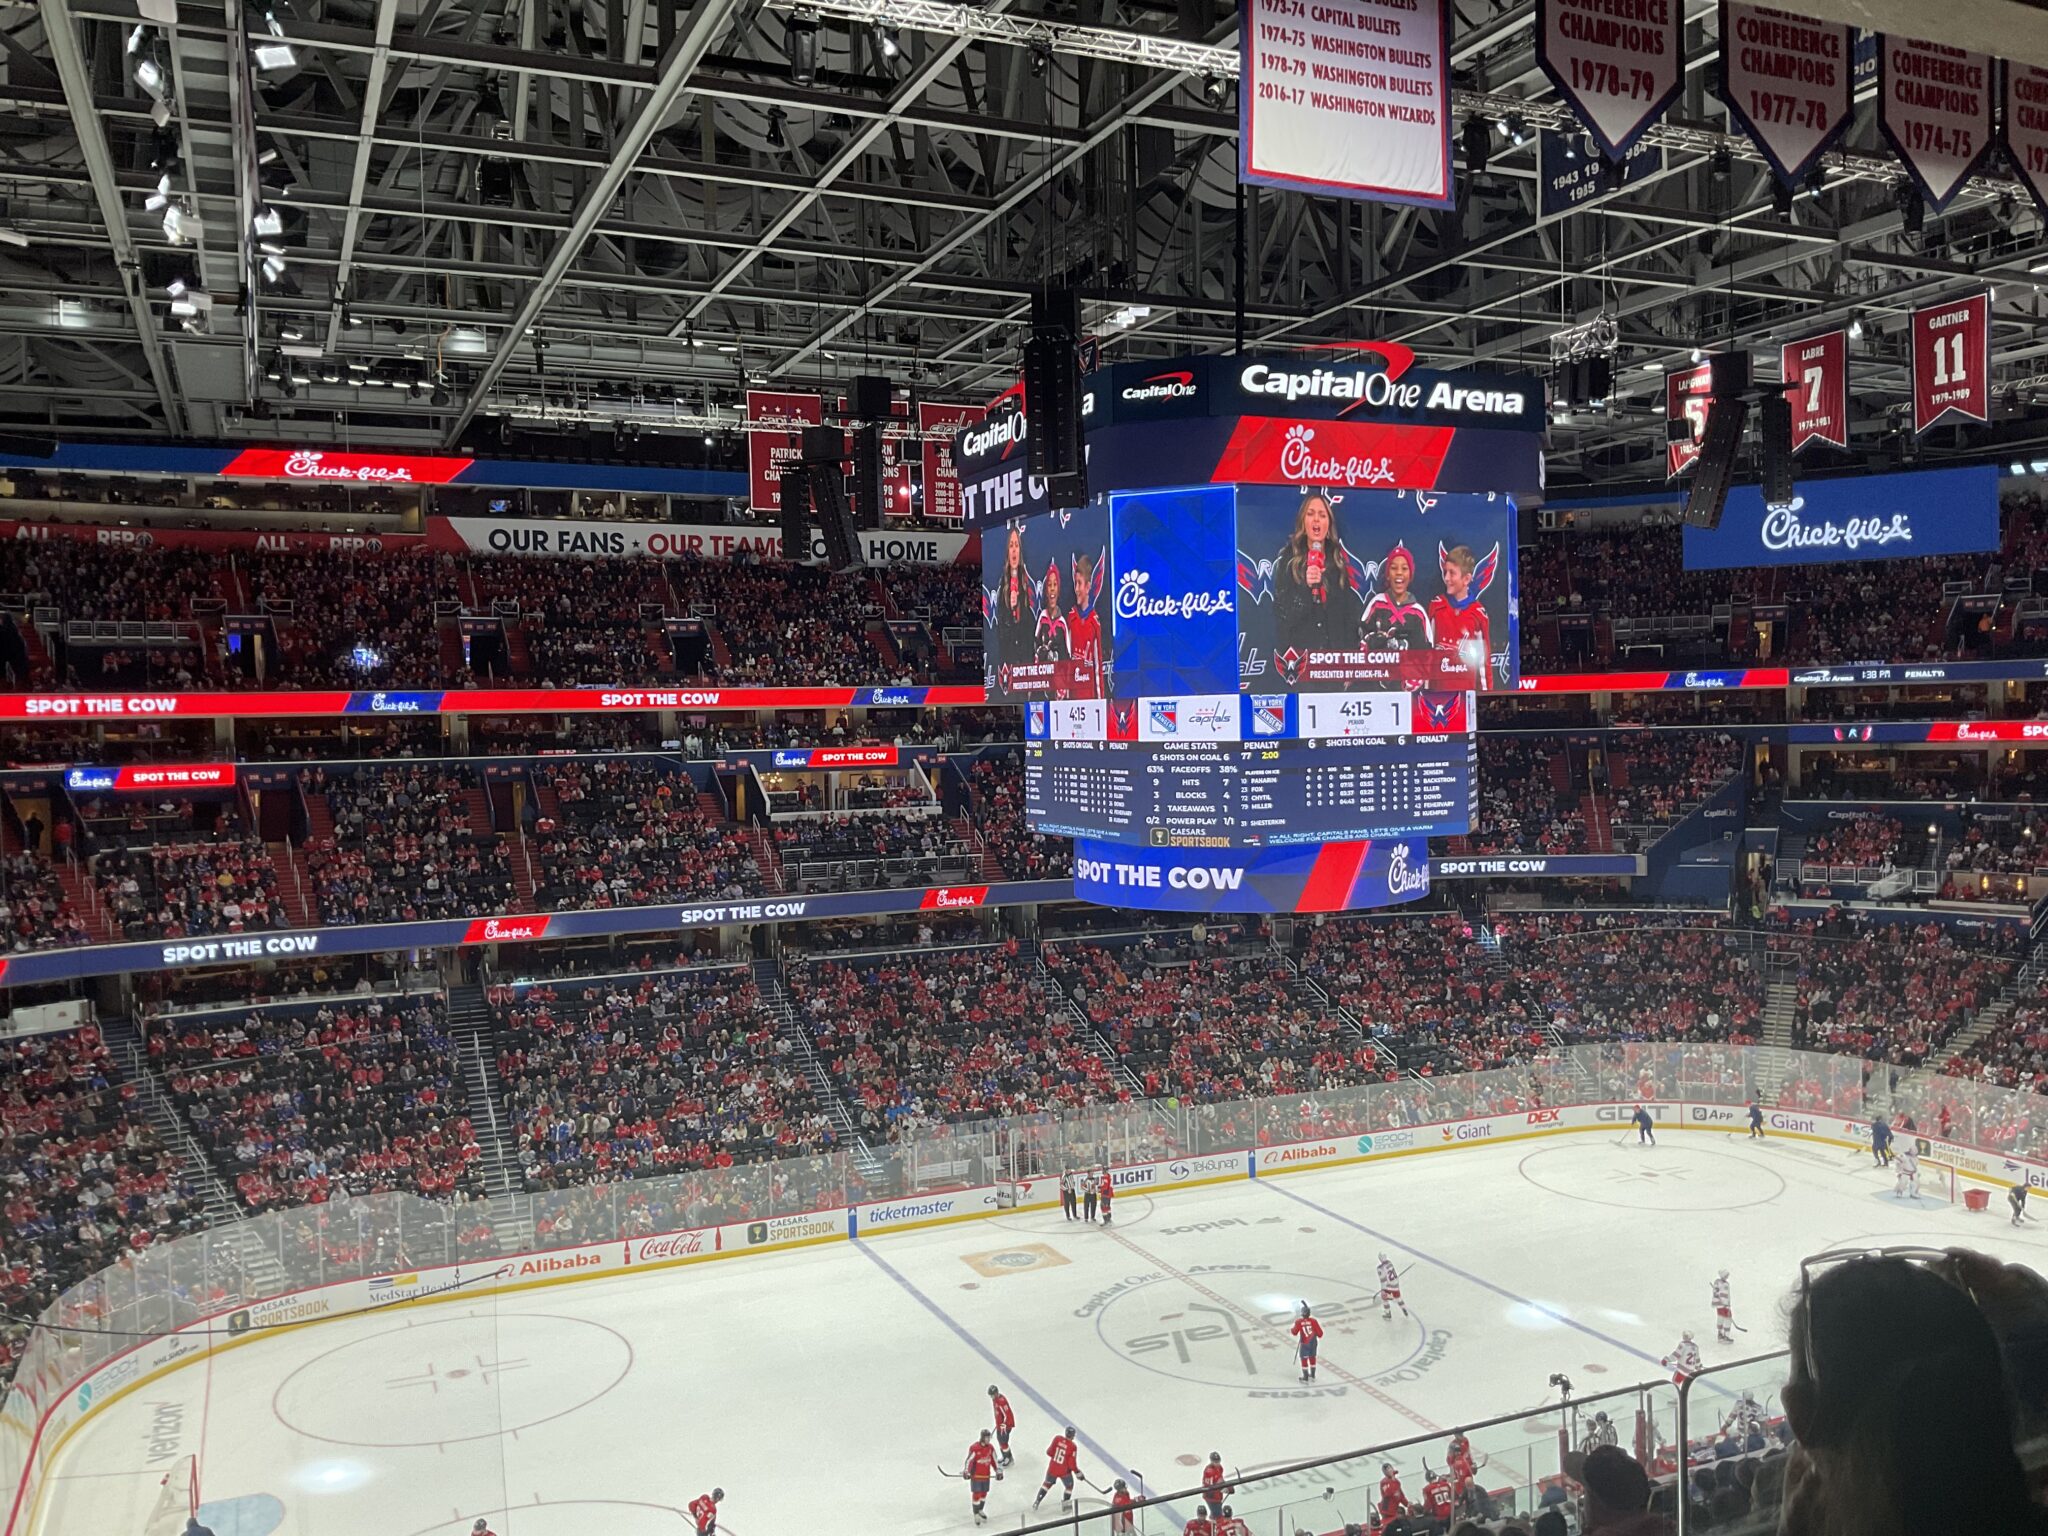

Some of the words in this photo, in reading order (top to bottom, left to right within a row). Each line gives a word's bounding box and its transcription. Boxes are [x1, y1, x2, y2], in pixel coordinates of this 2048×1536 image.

[1311, 6, 1355, 29] CAPITAL
[1357, 15, 1401, 36] BULLETS
[1559, 12, 1664, 55] CHAMPIONS
[1737, 16, 1840, 59] CONFERENCE
[1260, 23, 1306, 47] 1974-75
[1311, 33, 1386, 61] WASHINGTON
[1389, 50, 1432, 69] BULLETS
[1260, 53, 1306, 76] 1978-79
[1312, 63, 1387, 91] WASHINGTON
[1389, 77, 1433, 97] BULLETS
[1741, 48, 1835, 87] CHAMPIONS
[1892, 50, 1983, 90] CONFERENCE
[1570, 57, 1654, 102] 1978-79
[1259, 83, 1305, 105] 2016-17
[1311, 91, 1386, 119] WASHINGTON
[1388, 104, 1436, 126] WIZARDS
[1895, 79, 1979, 116] CHAMPIONS
[1750, 90, 1827, 131] 1977-78
[1904, 120, 1972, 158] 1974-75
[1929, 310, 1970, 330] GARTNER
[1802, 344, 1825, 361] LABRE
[1933, 332, 1967, 387] 11
[1804, 366, 1824, 412] 7
[1931, 388, 1970, 405] 1979-1989
[770, 447, 803, 460] PATRICK
[981, 468, 1023, 514] THE
[488, 528, 550, 554] OUR
[558, 530, 625, 554] FANS
[647, 533, 703, 556] OUR
[869, 540, 938, 561] HOME
[1309, 652, 1341, 664] SPOT
[1342, 652, 1366, 664] THE
[1367, 652, 1400, 664] COW!
[1309, 670, 1344, 678] PRESENTED
[1345, 670, 1354, 678] BY
[1355, 670, 1389, 678] CHICK-FIL-A
[25, 698, 80, 714] SPOT
[84, 697, 123, 713] THE
[127, 697, 177, 713] COW
[601, 693, 645, 707] SPOT
[647, 692, 678, 706] THE
[680, 692, 720, 706] COW
[1339, 701, 1372, 716] 4:15
[1069, 707, 1086, 721] 4:15
[1258, 709, 1283, 732] RANGERS
[1307, 705, 1317, 729] 1
[1391, 703, 1399, 726] 1
[1191, 742, 1218, 750] STATS
[1244, 742, 1279, 750] PENALTY
[1308, 739, 1316, 749] 6
[1326, 739, 1351, 747] SHOTS
[1365, 737, 1386, 745] GOAL
[1398, 735, 1405, 745] 6
[1416, 735, 1448, 744] PENALTY
[822, 753, 846, 762] SPOT
[847, 753, 864, 761] THE
[865, 752, 887, 760] COW
[1241, 752, 1251, 760] 77
[1262, 751, 1279, 760] 2:00
[133, 772, 164, 782] SPOT
[166, 771, 188, 781] THE
[191, 770, 220, 781] COW
[1219, 765, 1238, 773] 38%
[1153, 791, 1159, 799] 3
[1223, 791, 1230, 799] 4
[1153, 804, 1159, 812] 2
[1145, 817, 1160, 825] 0/2
[1166, 817, 1196, 825] POWER
[1196, 817, 1217, 825] PLAY
[1223, 817, 1234, 825] 1/1
[1170, 836, 1231, 847] SPORTSBOOK
[1077, 857, 1112, 884] SPOT
[1114, 864, 1162, 889] THE
[1167, 866, 1244, 890] COW
[1440, 861, 1477, 874] SPOT
[1479, 861, 1505, 872] THE
[1508, 860, 1547, 872] COW
[681, 908, 726, 924] SPOT
[728, 906, 761, 919] THE
[764, 902, 806, 917] COW
[163, 943, 219, 962] SPOT
[223, 940, 262, 957] THE
[266, 936, 317, 954] COW
[1526, 1109, 1560, 1125] DEX
[1771, 1113, 1815, 1133] Giant
[1457, 1124, 1492, 1140] Giant
[1281, 1145, 1337, 1162] Alibaba
[1113, 1169, 1153, 1184] LIGHT
[870, 1200, 954, 1223] ticketmaster
[770, 1215, 809, 1228] CAESARS
[770, 1220, 835, 1241] SPORTSBOOK
[519, 1252, 601, 1276] Alibaba
[1188, 1264, 1271, 1273] Arena
[369, 1285, 418, 1303] MedStar
[252, 1296, 298, 1315] CAESARS
[253, 1300, 330, 1328] SPORTSBOOK
[1248, 1385, 1349, 1399] Arena
[146, 1403, 184, 1464] verizon
[1054, 1447, 1066, 1465] 16
